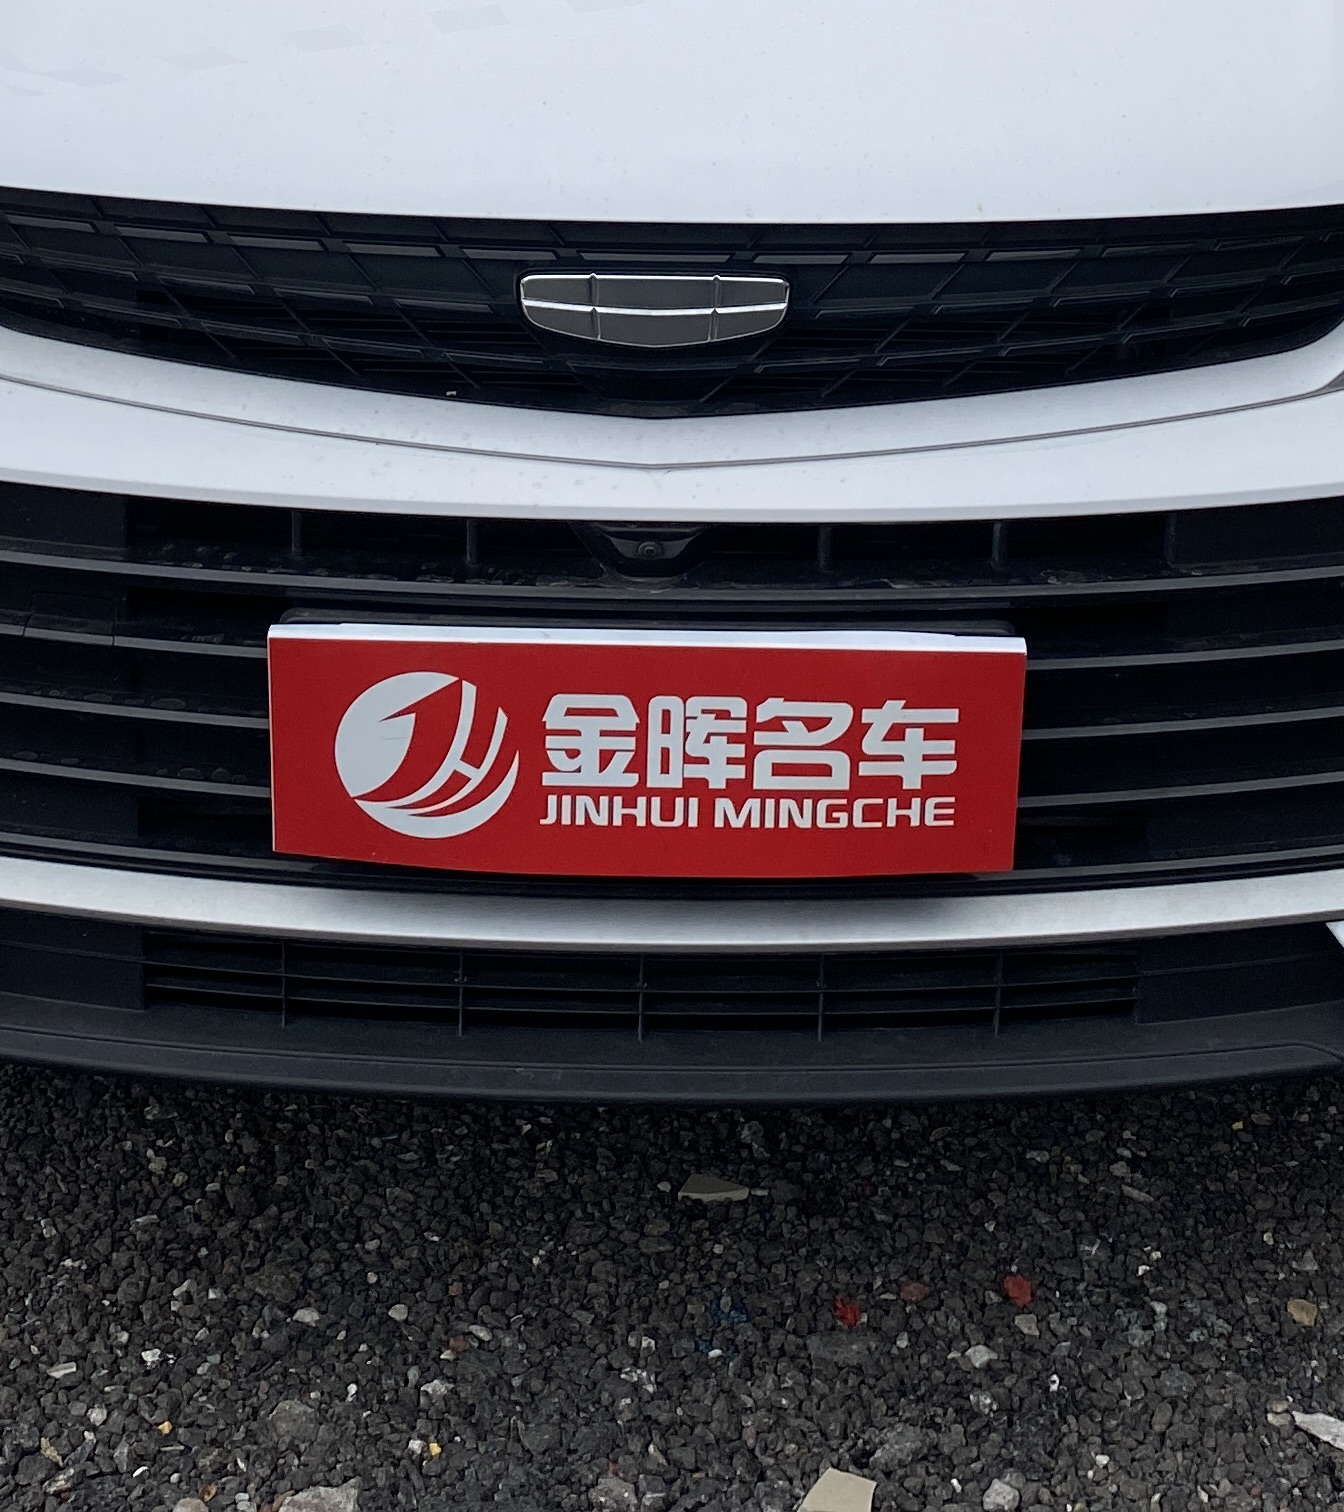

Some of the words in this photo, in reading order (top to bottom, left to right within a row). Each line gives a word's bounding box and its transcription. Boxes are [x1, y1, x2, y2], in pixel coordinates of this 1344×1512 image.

[542, 693, 959, 790] 金晖名车
[540, 794, 699, 828] JINHUI
[713, 795, 957, 829] MINGCHE
